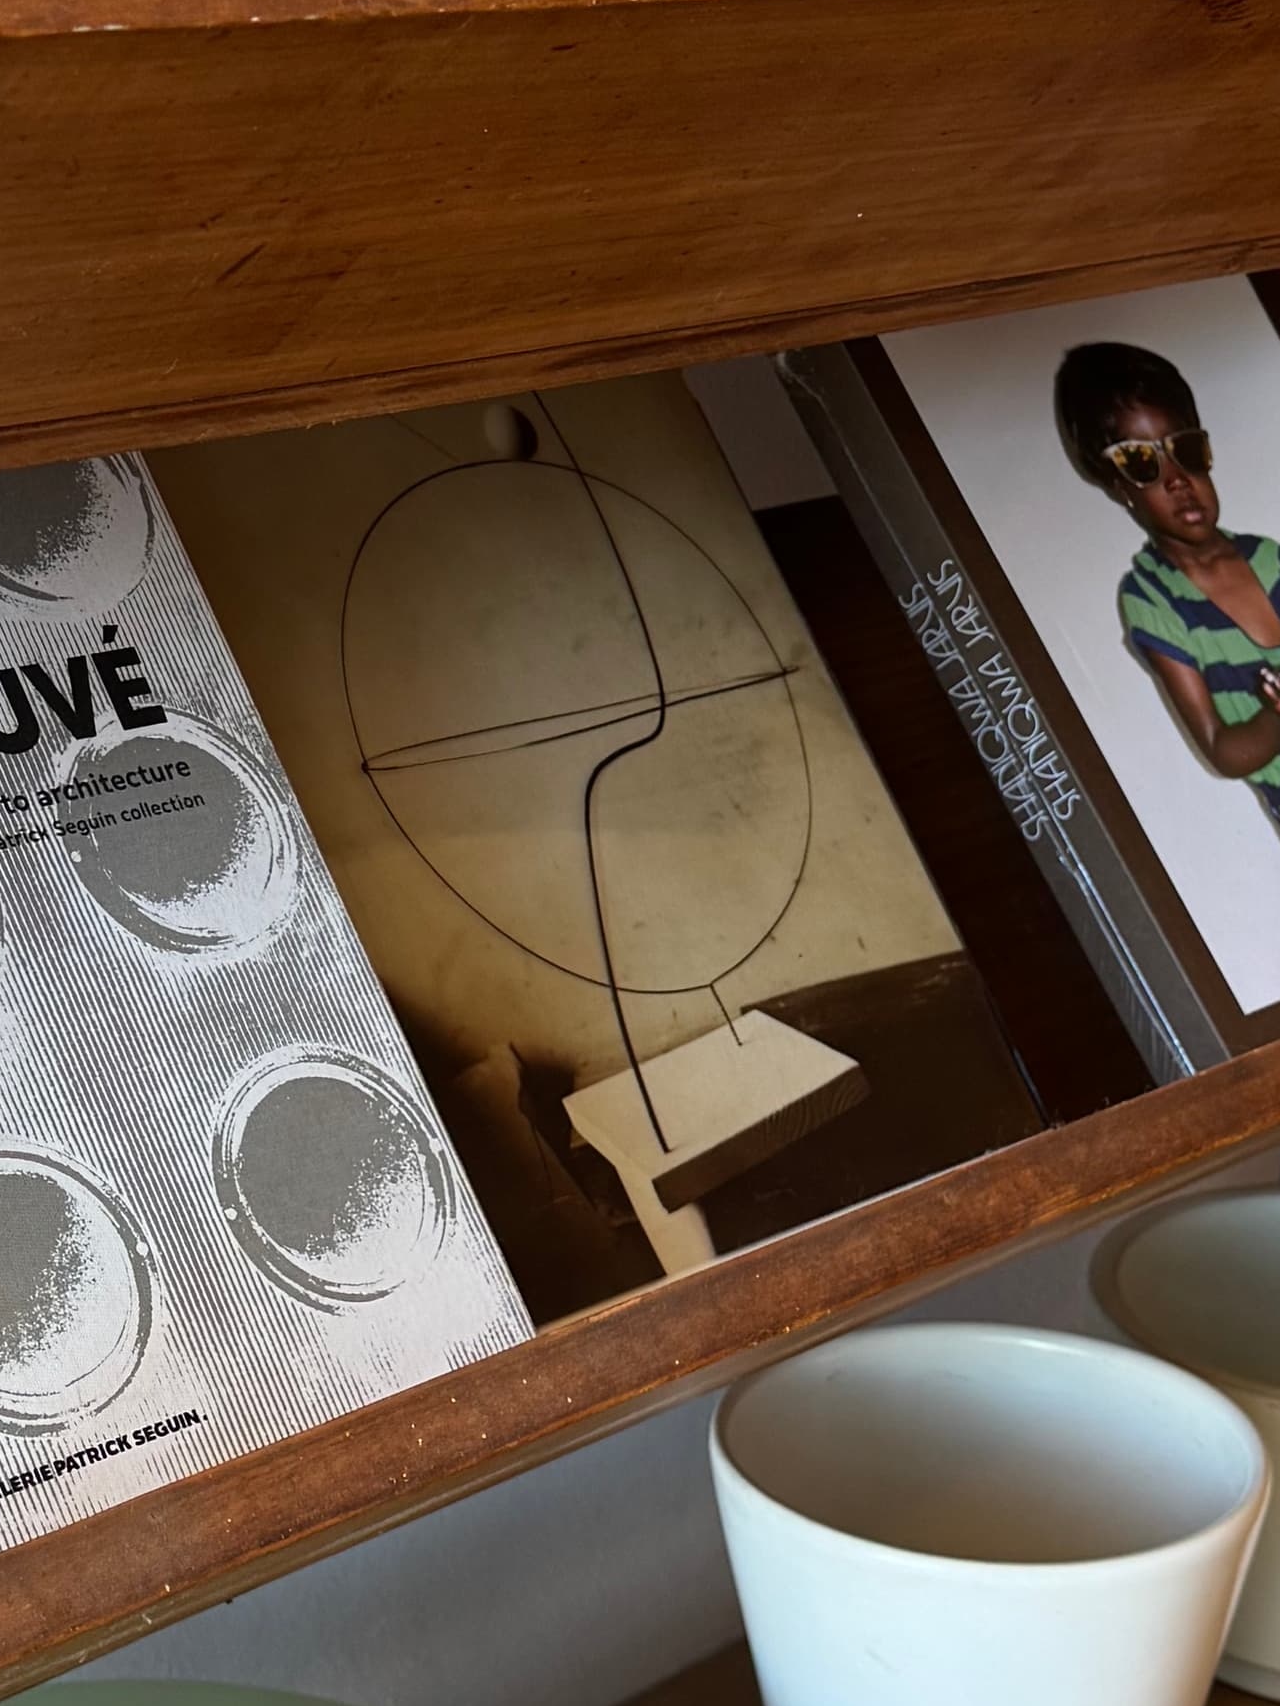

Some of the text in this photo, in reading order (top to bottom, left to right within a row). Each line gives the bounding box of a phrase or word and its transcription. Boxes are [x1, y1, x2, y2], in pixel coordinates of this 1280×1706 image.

[927, 559, 995, 648] JARVIS
[0, 794, 30, 816] to
[38, 760, 192, 808] architecture
[53, 810, 118, 840] Seguin
[120, 792, 206, 823] collection
[52, 1434, 135, 1476] PATRICK
